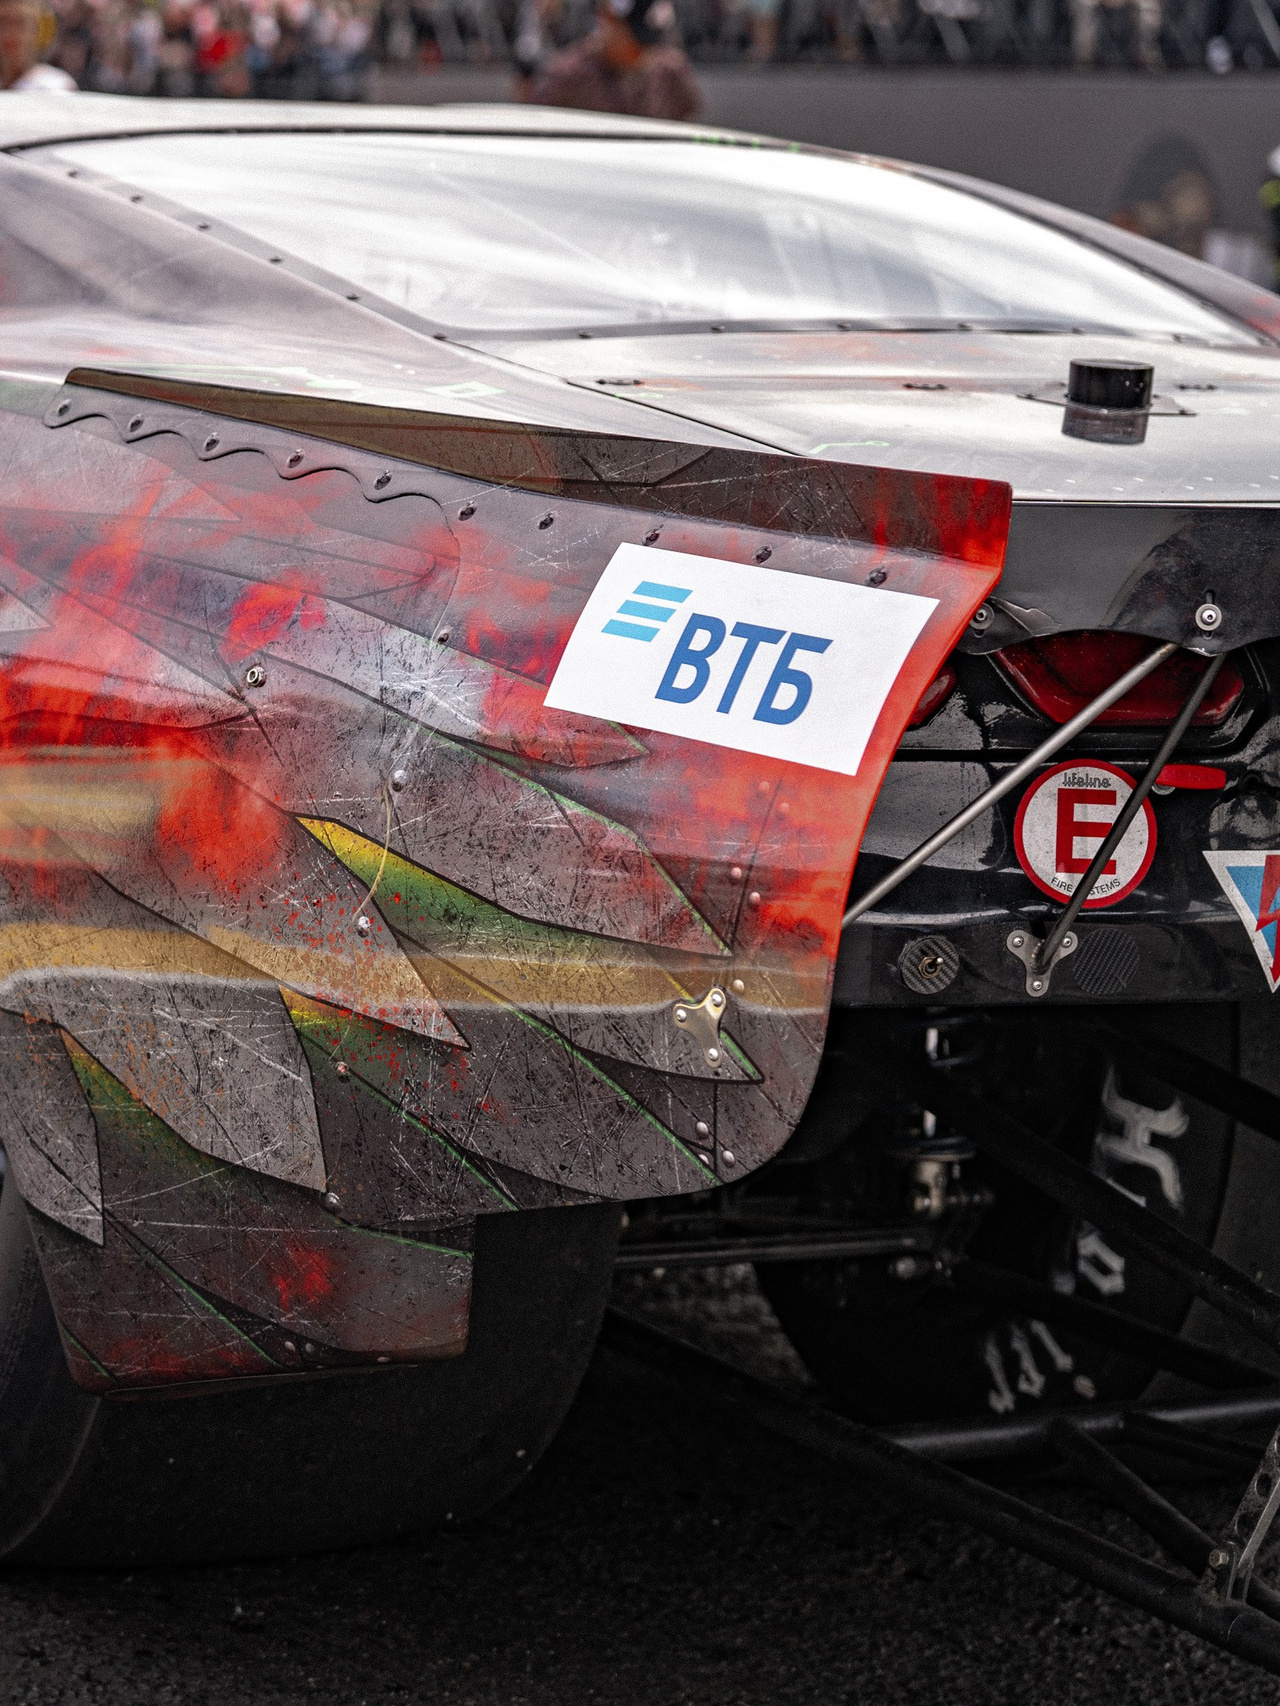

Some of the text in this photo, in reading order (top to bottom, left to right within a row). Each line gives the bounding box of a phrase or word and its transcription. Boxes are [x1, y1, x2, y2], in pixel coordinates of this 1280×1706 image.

[655, 613, 833, 725] ВТБ
[1062, 772, 1111, 788] lifeline
[1055, 788, 1117, 875] E
[1051, 877, 1121, 896] FIRE STEMS
